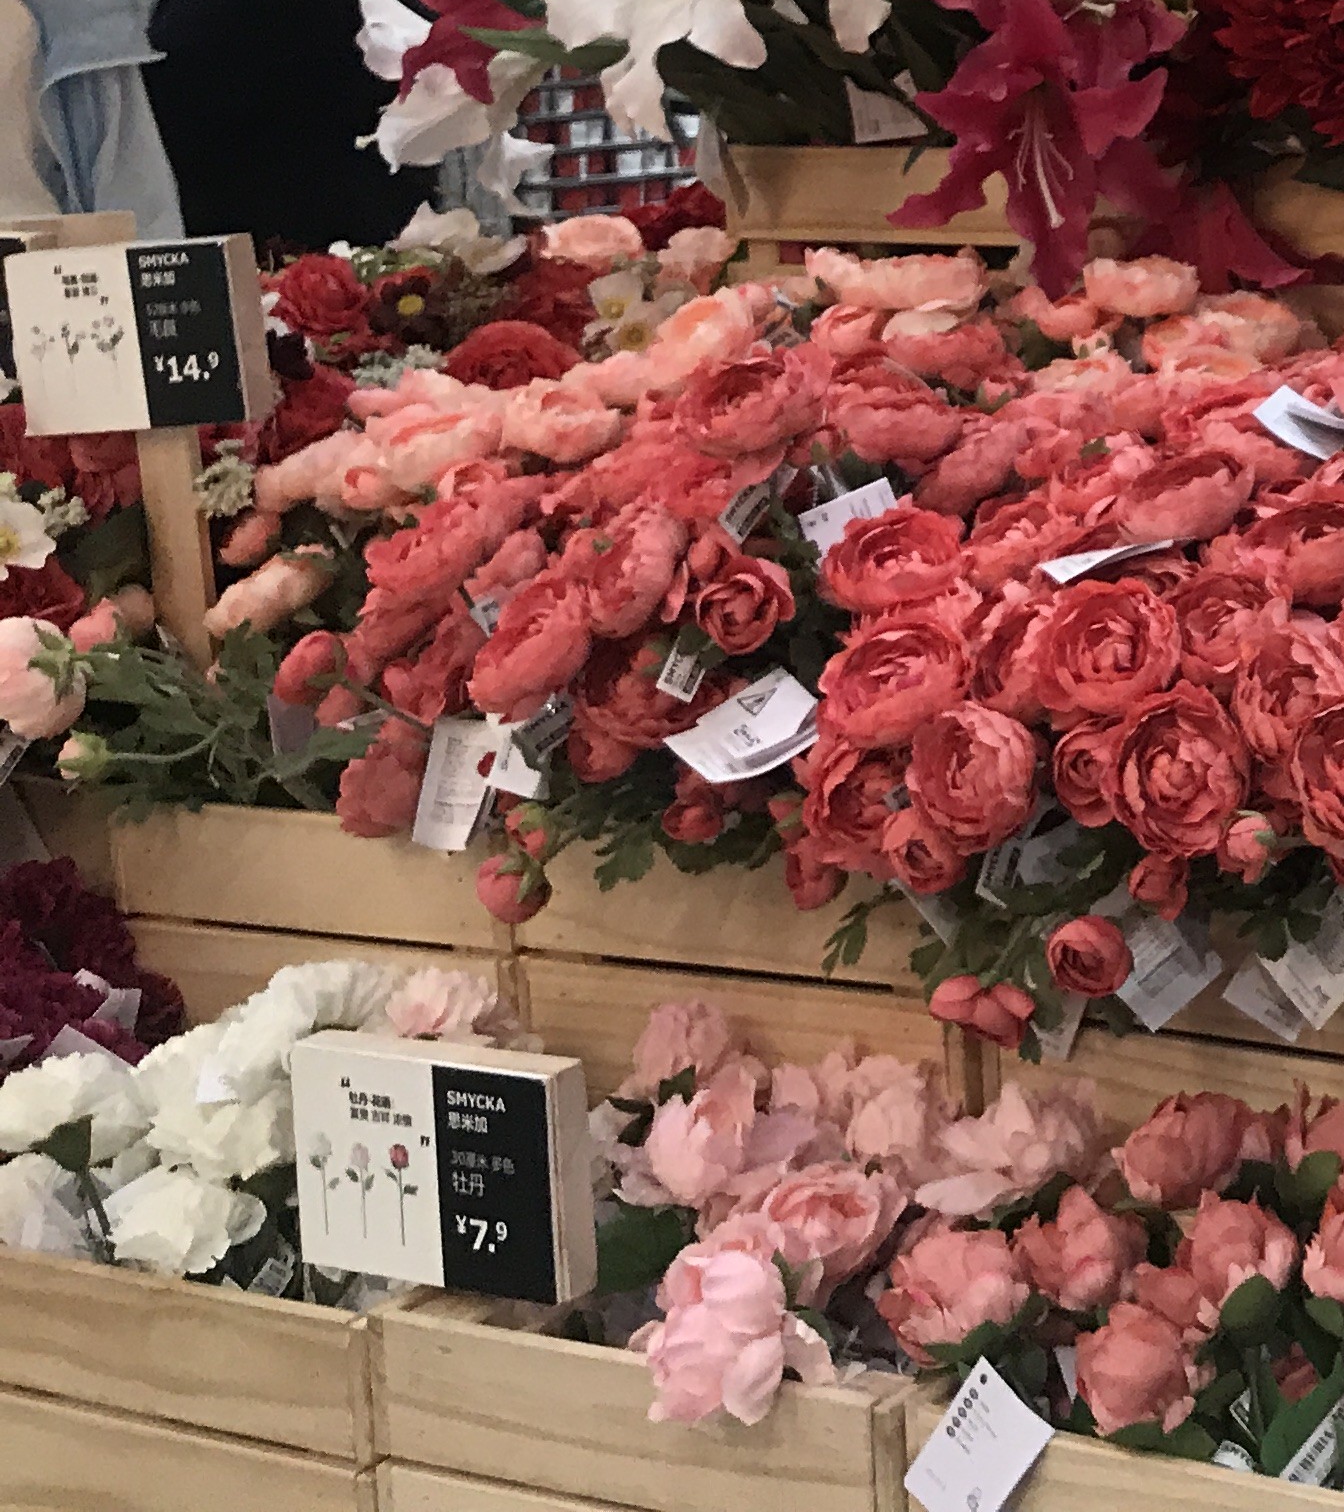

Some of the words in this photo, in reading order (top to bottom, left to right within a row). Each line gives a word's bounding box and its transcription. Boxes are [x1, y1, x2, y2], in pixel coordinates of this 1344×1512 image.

[138, 252, 189, 269] SMYCKA
[154, 351, 220, 385] ¥14.9
[446, 1090, 506, 1113] SMYCKA
[447, 1113, 488, 1134] 思米加
[452, 1171, 485, 1197] 牡丹
[456, 1215, 508, 1254] ¥7.9
